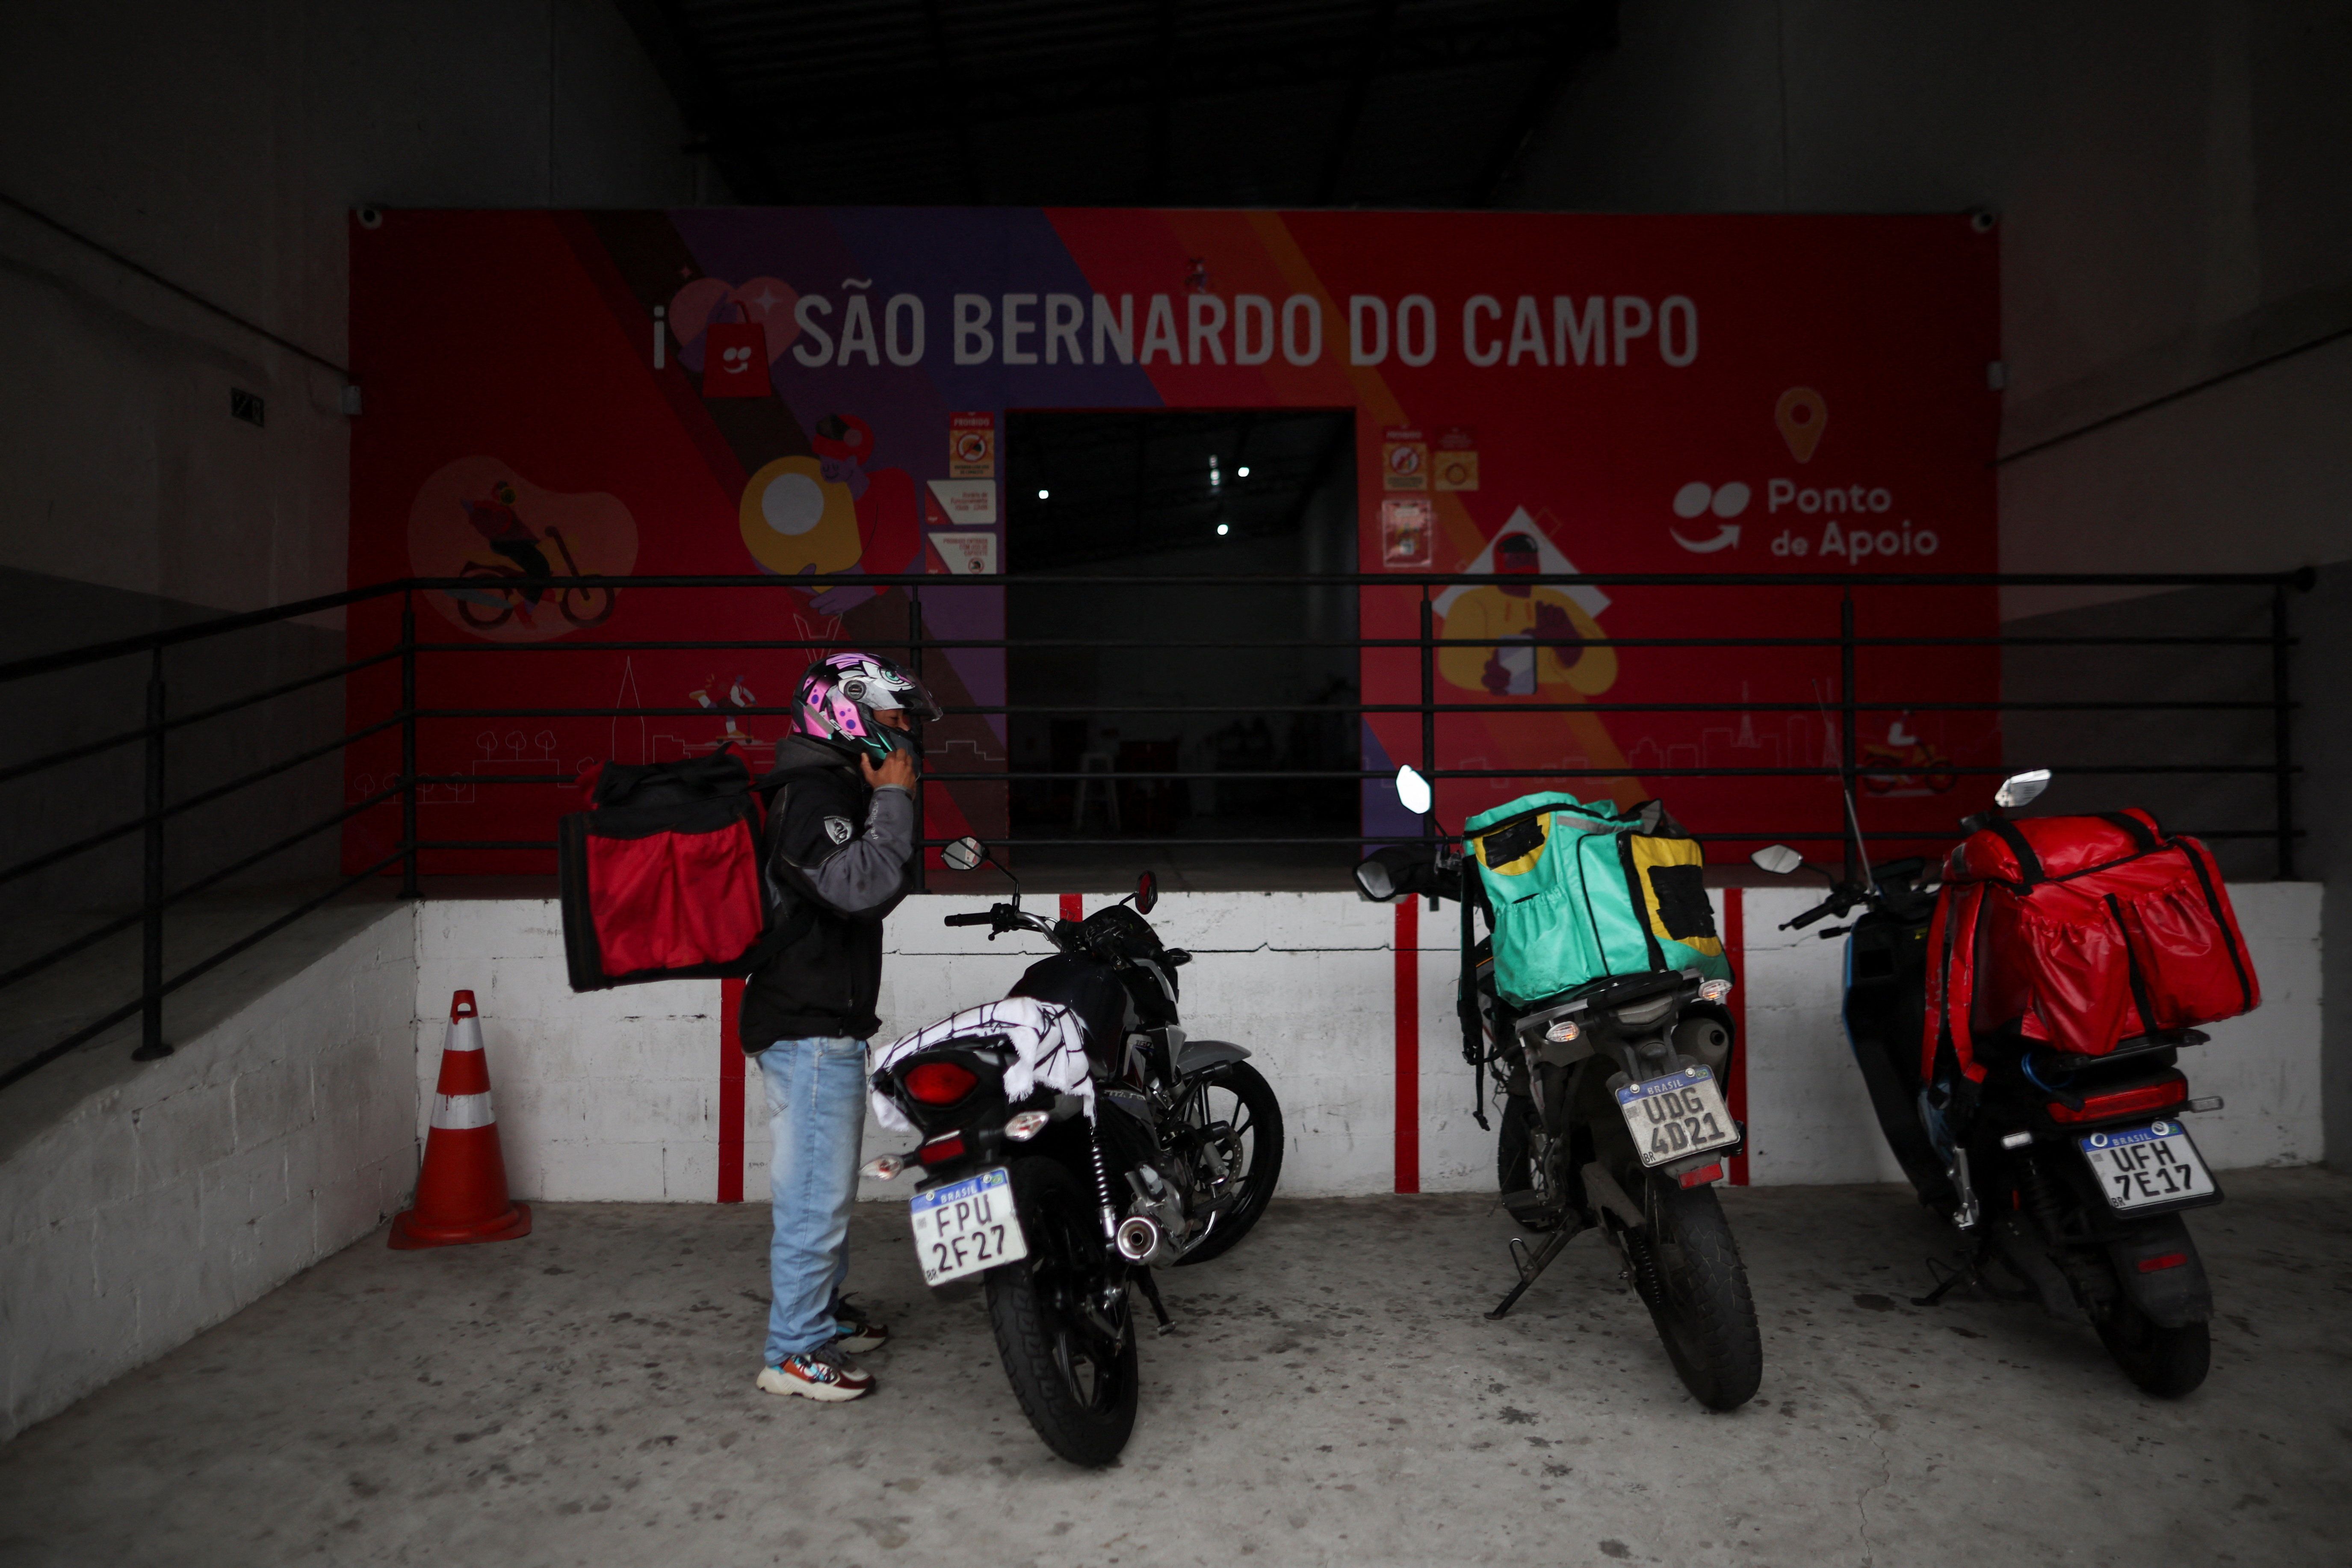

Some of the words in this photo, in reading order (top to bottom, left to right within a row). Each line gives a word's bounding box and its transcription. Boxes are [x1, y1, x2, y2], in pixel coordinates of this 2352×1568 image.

[792, 278, 926, 367] SÃO
[953, 293, 1323, 366] BERNARDO
[1349, 294, 1437, 368] DO
[1462, 293, 1699, 368] CAMPO
[1767, 477, 1893, 514] Ponto
[1770, 529, 1810, 557] de
[1818, 517, 1940, 567] Apoio
[1135, 1039, 1152, 1048] 160
[1647, 1079, 1684, 1095] BRASIL
[1643, 1087, 1704, 1124] UDG
[1652, 1113, 1725, 1154] 4D21
[2112, 1133, 2151, 1146] BRASIL
[1643, 1151, 1656, 1163] BR
[2110, 1140, 2175, 1172] UFH
[940, 1185, 978, 1204] BRASIL
[2114, 1163, 2191, 1201] 7E17
[935, 1193, 992, 1237] FPU
[2112, 1196, 2125, 1208] BR
[932, 1224, 1005, 1273] 2F27
[926, 1269, 938, 1281] BR
